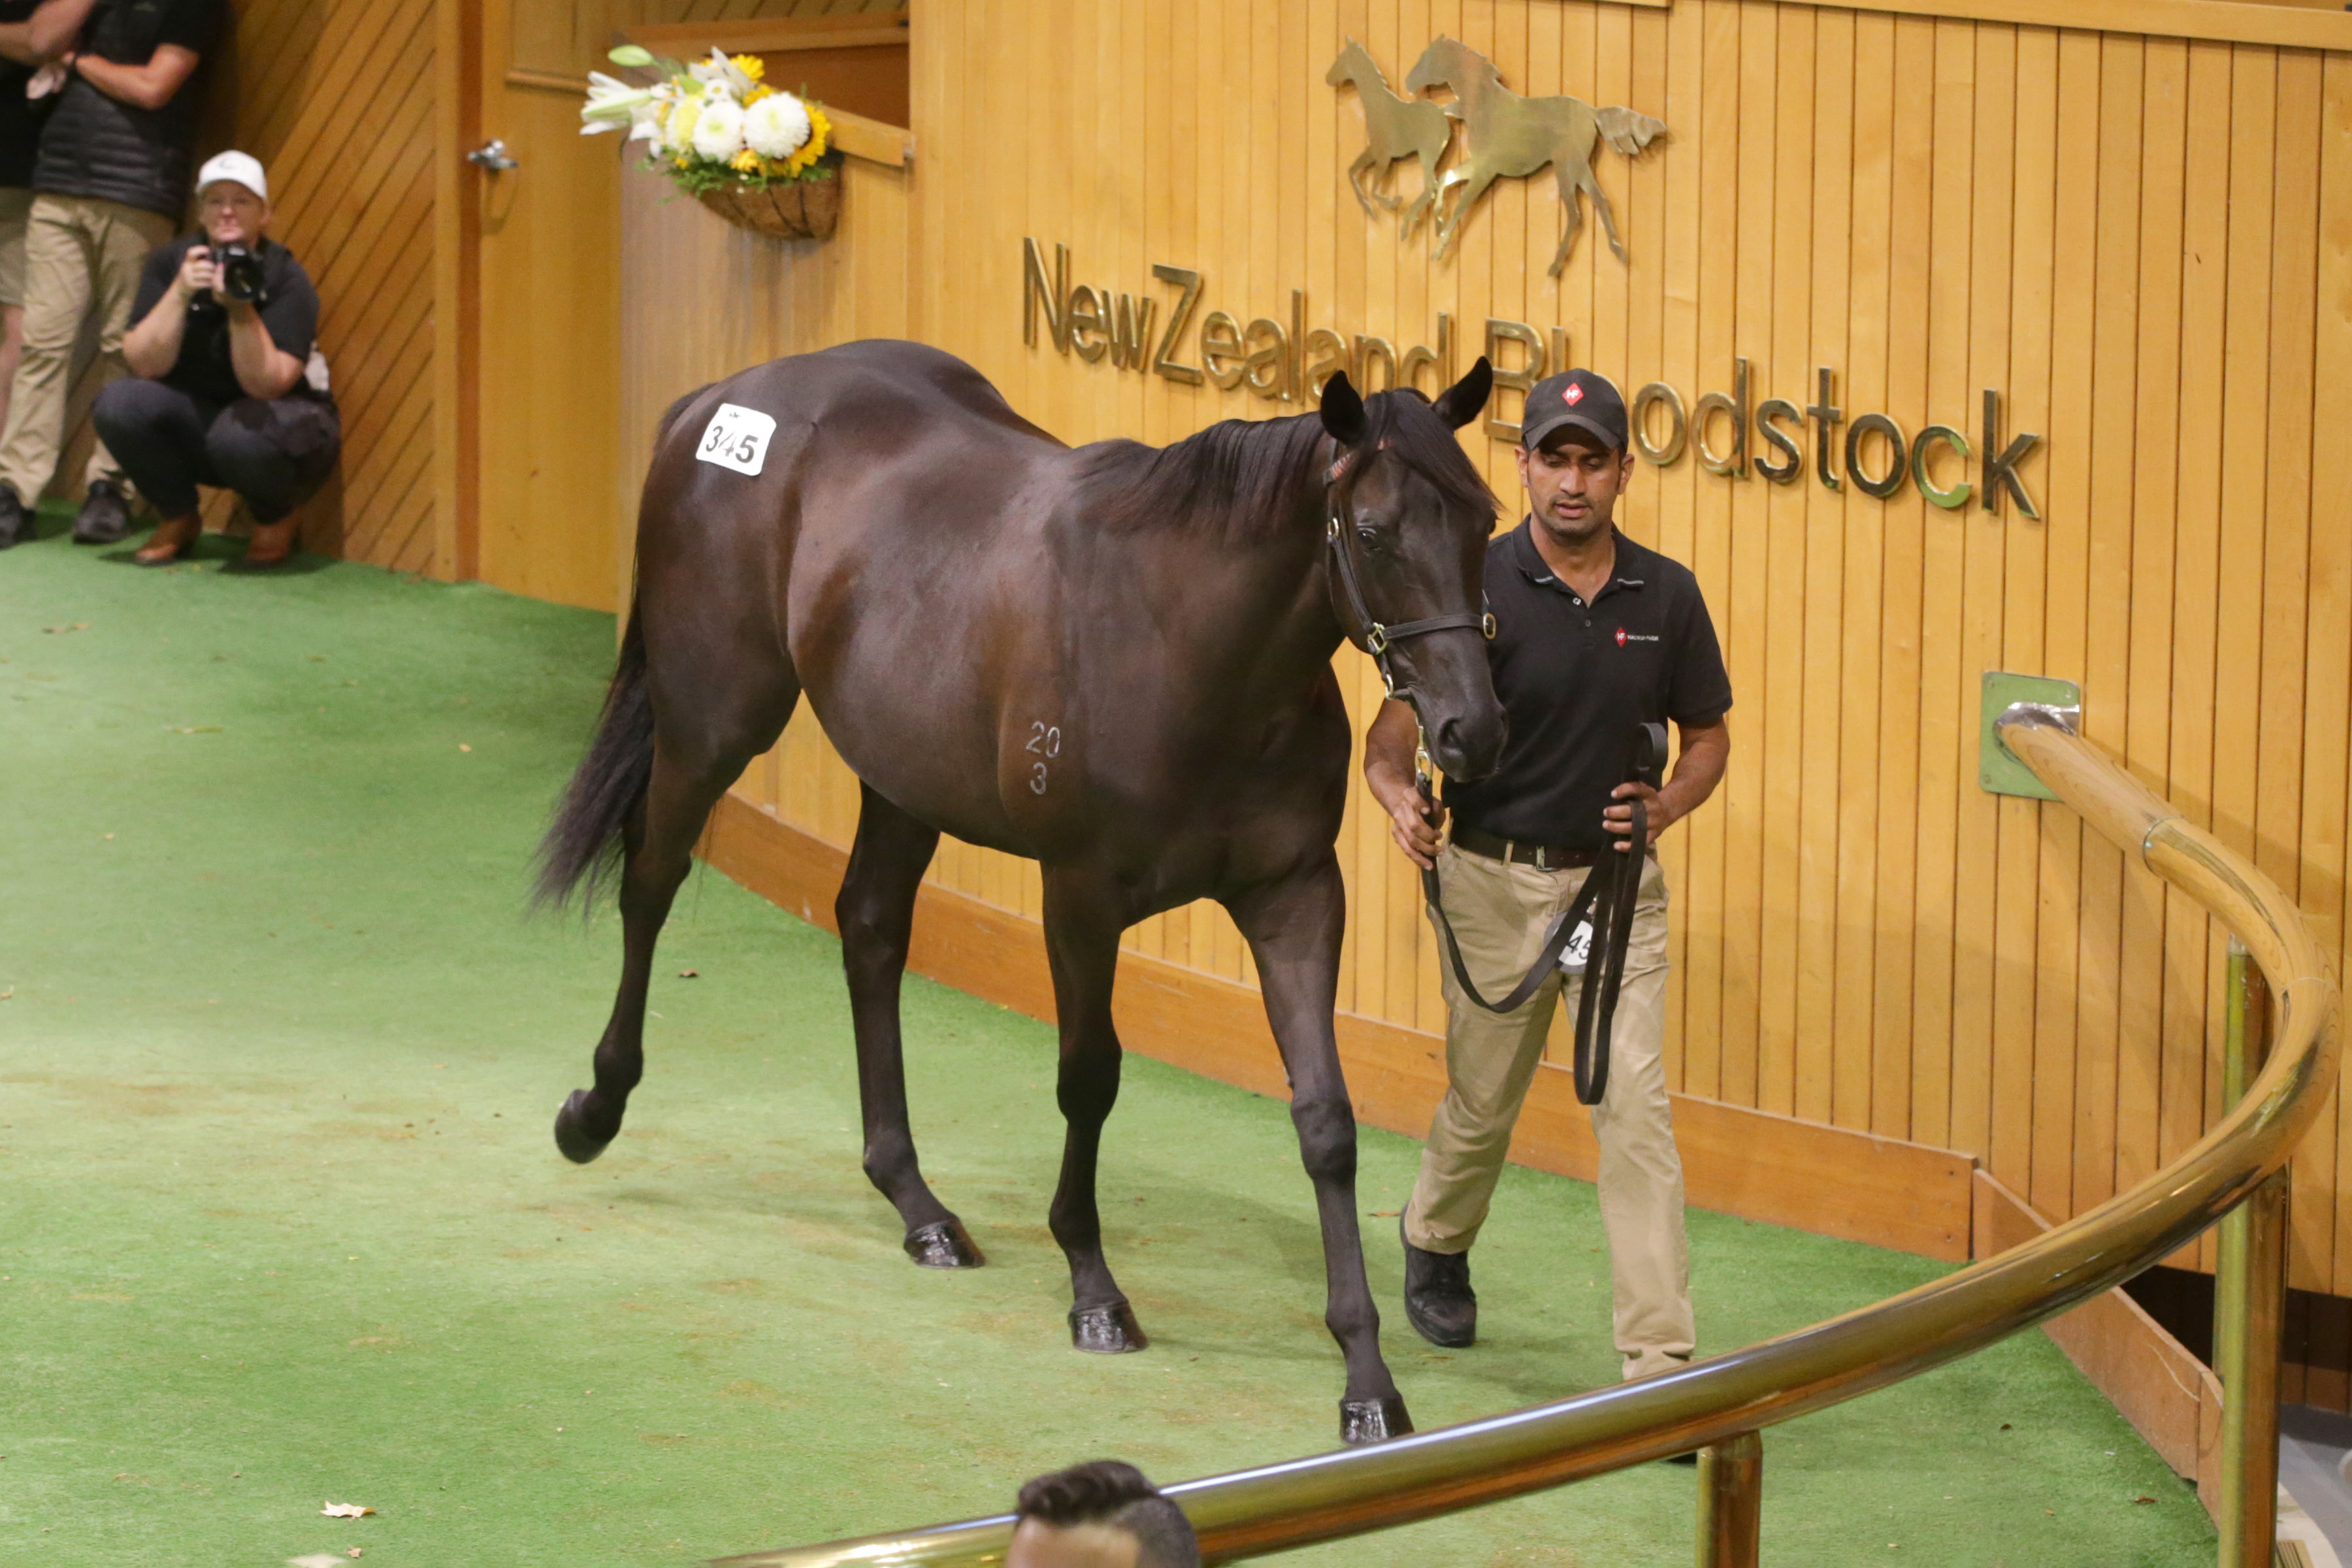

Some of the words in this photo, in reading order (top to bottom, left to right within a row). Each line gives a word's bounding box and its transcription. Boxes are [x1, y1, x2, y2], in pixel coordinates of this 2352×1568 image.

[1565, 389, 1580, 399] HF
[1483, 318, 2040, 520] Bodstock
[706, 425, 759, 464] 345
[1025, 720, 1060, 759] 20
[1030, 762, 1047, 794] 3
